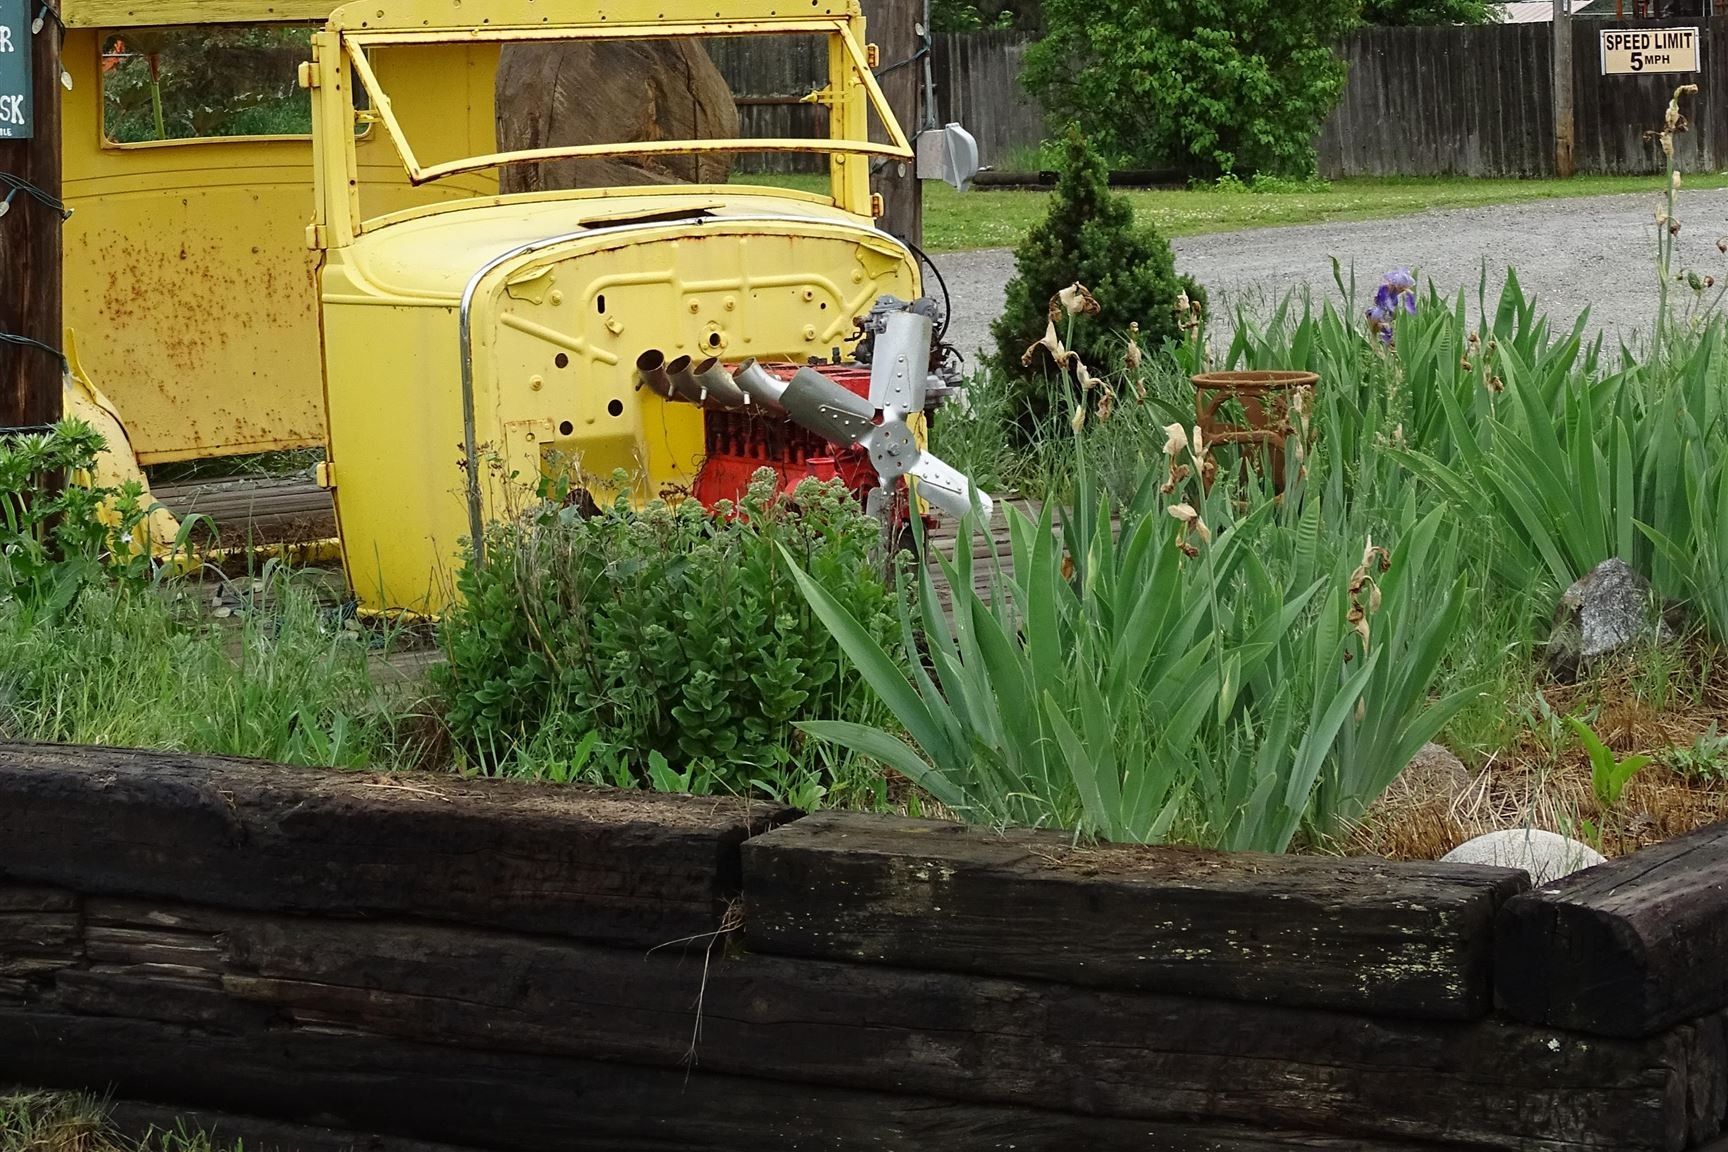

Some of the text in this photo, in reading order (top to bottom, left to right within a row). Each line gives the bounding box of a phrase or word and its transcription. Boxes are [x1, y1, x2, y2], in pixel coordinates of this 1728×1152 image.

[1606, 32, 1692, 51] SPEED LIMIT
[1630, 51, 1670, 71] 5 MPH
